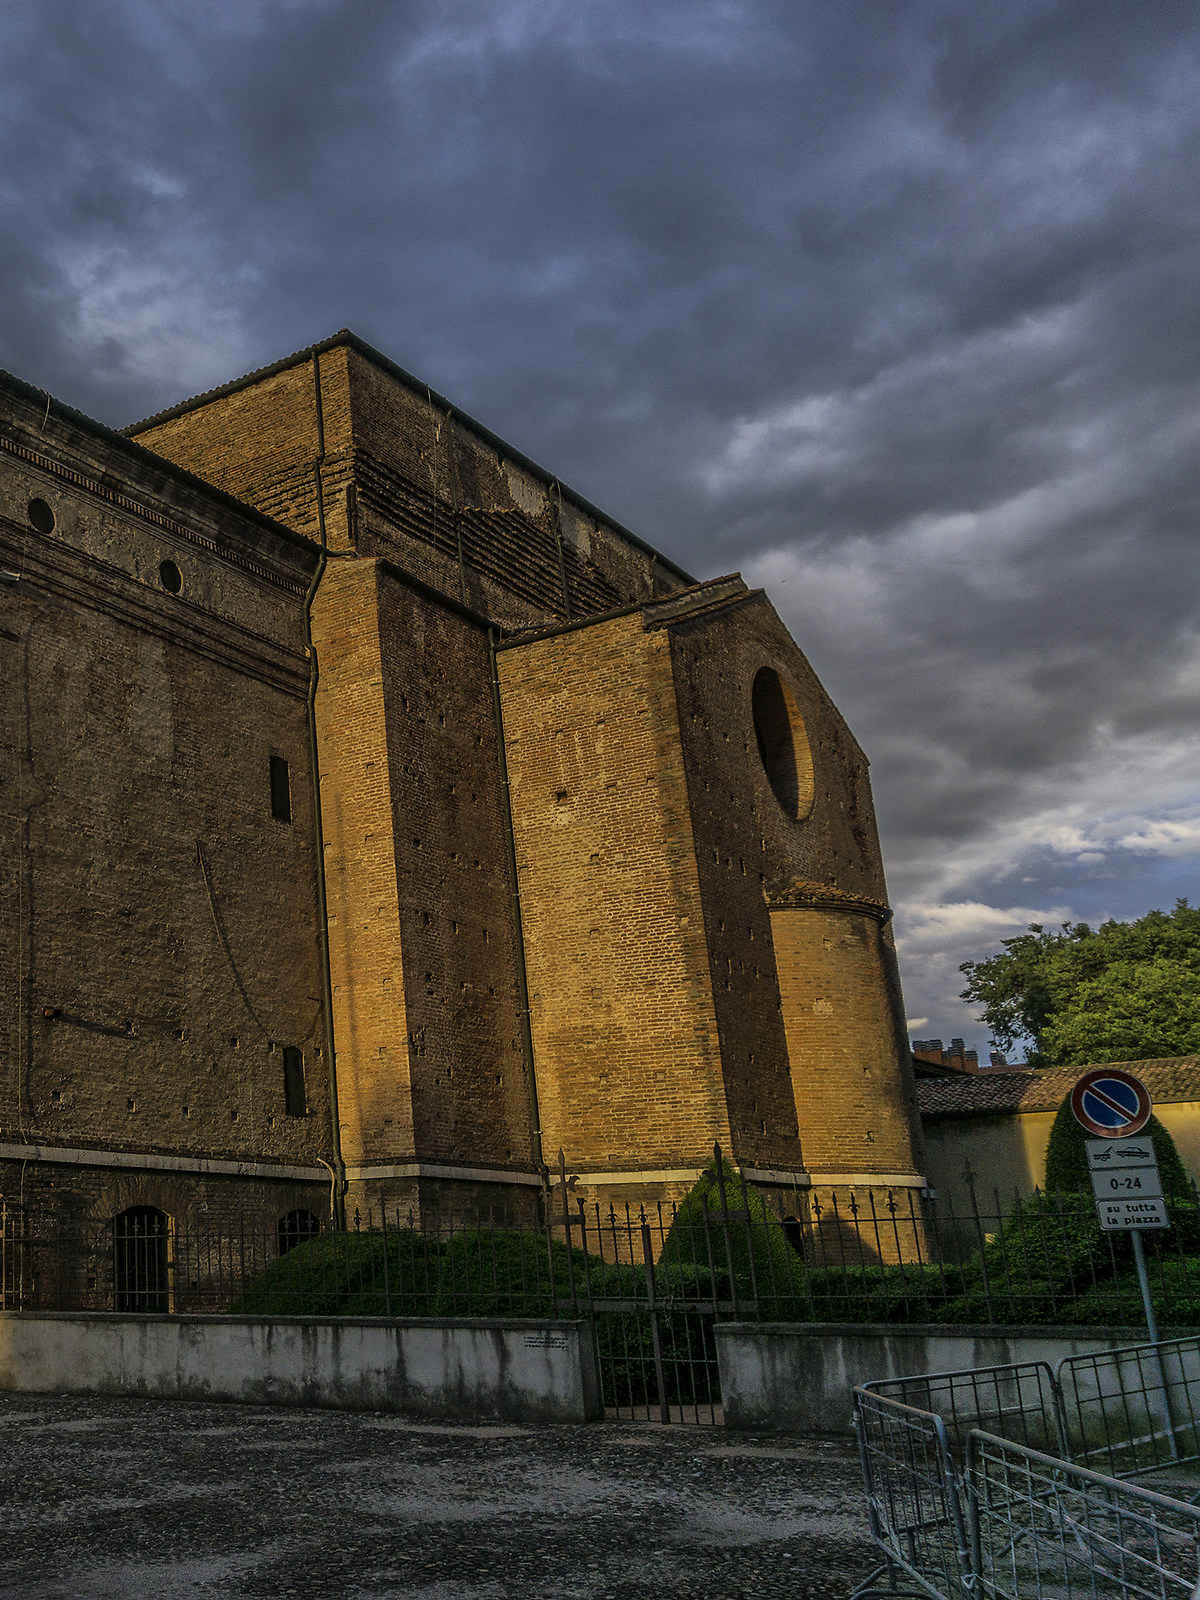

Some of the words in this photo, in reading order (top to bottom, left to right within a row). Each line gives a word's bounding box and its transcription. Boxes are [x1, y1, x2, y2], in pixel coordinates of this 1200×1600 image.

[1110, 1178, 1142, 1190] 0-24
[1125, 1203, 1157, 1213] tutta
[1107, 1216, 1119, 1225] la
[1124, 1216, 1161, 1226] piazza
